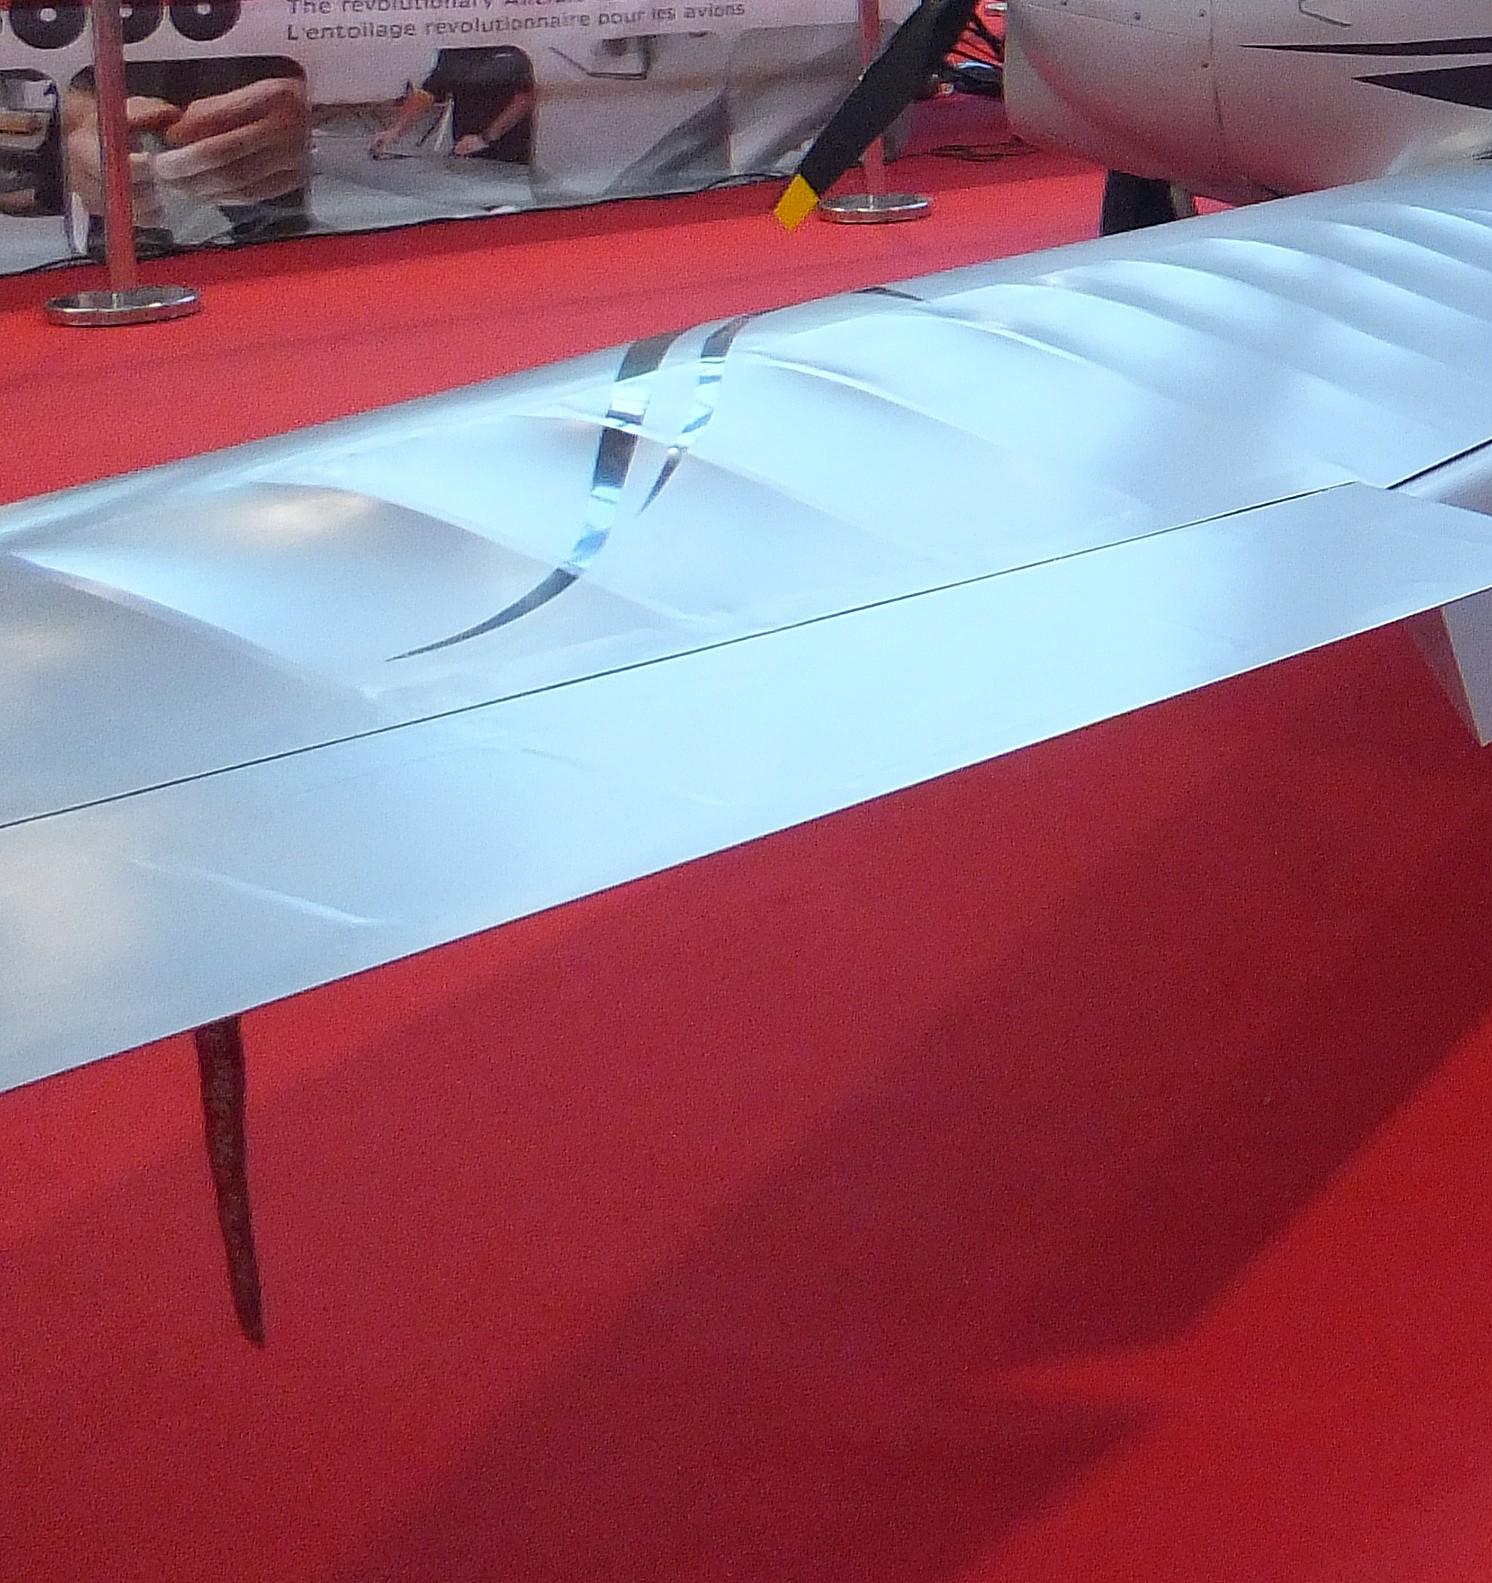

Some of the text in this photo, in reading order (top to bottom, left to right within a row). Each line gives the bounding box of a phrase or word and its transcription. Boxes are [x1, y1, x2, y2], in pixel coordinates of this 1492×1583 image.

[287, 17, 418, 42] L'entoilage
[599, 8, 645, 29] pour
[683, 0, 747, 20] avions
